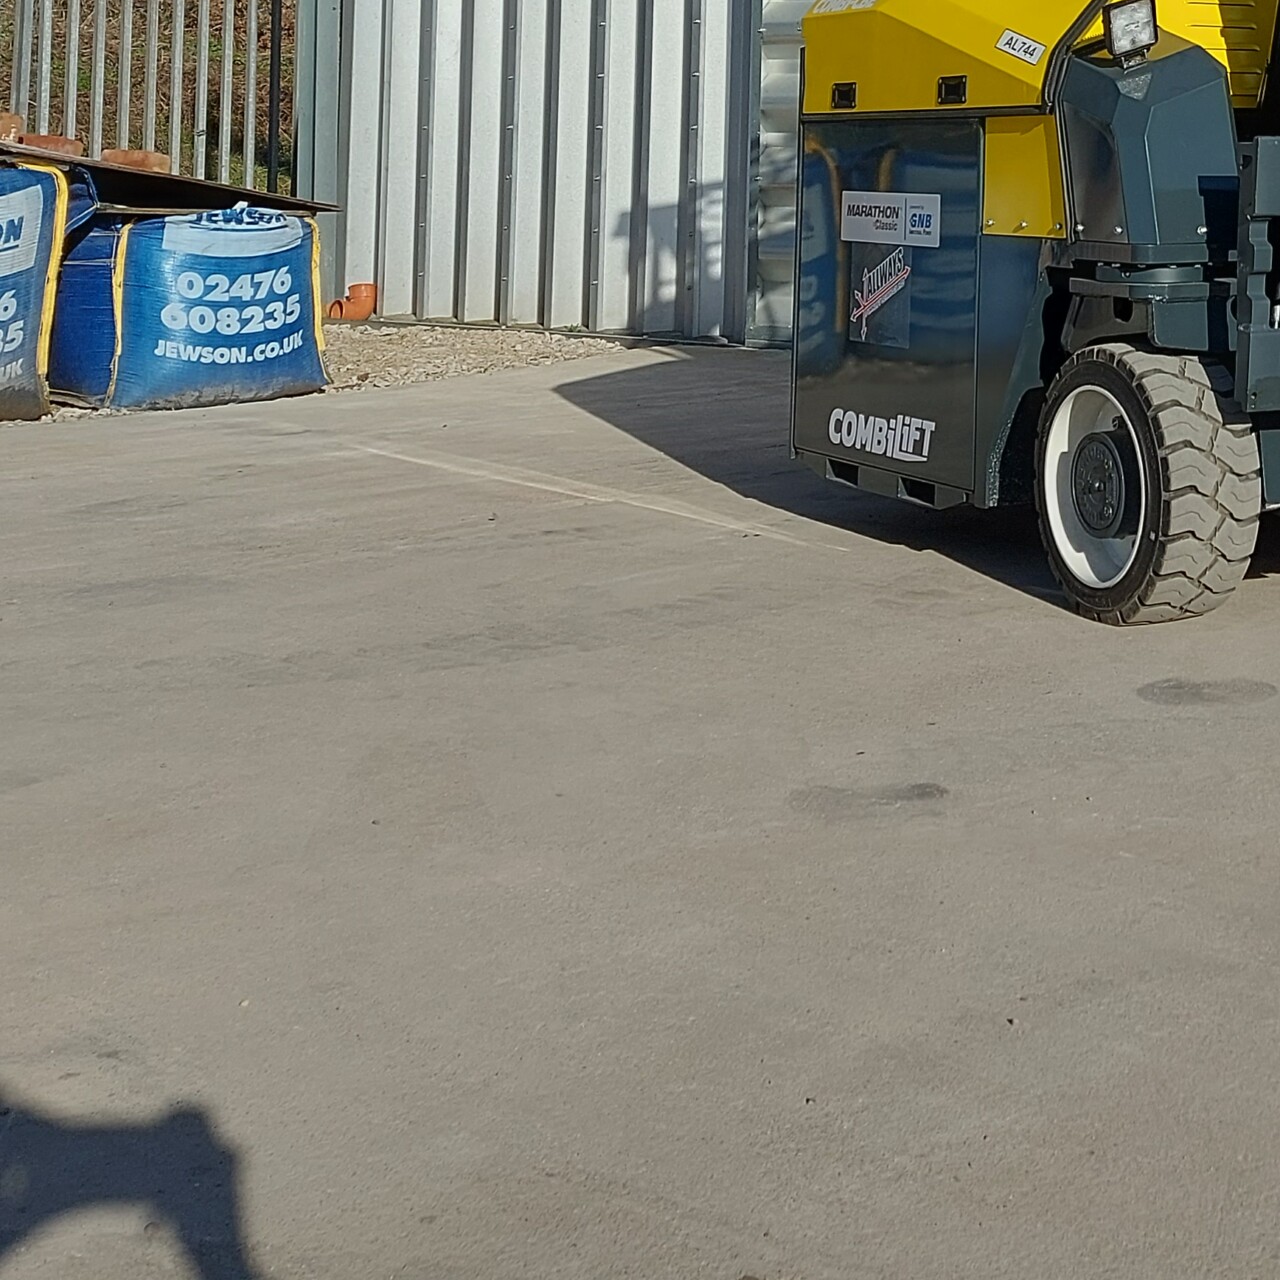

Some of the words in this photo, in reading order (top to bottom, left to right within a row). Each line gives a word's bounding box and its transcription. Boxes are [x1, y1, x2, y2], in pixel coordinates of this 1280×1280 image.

[1003, 36, 1038, 58] AL744
[846, 204, 900, 219] MARATHON
[909, 213, 932, 228] GNB
[872, 219, 898, 231] Classic
[176, 266, 292, 301] 02476
[161, 294, 301, 335] 608235
[154, 329, 304, 364] JEWSON.CO.UK
